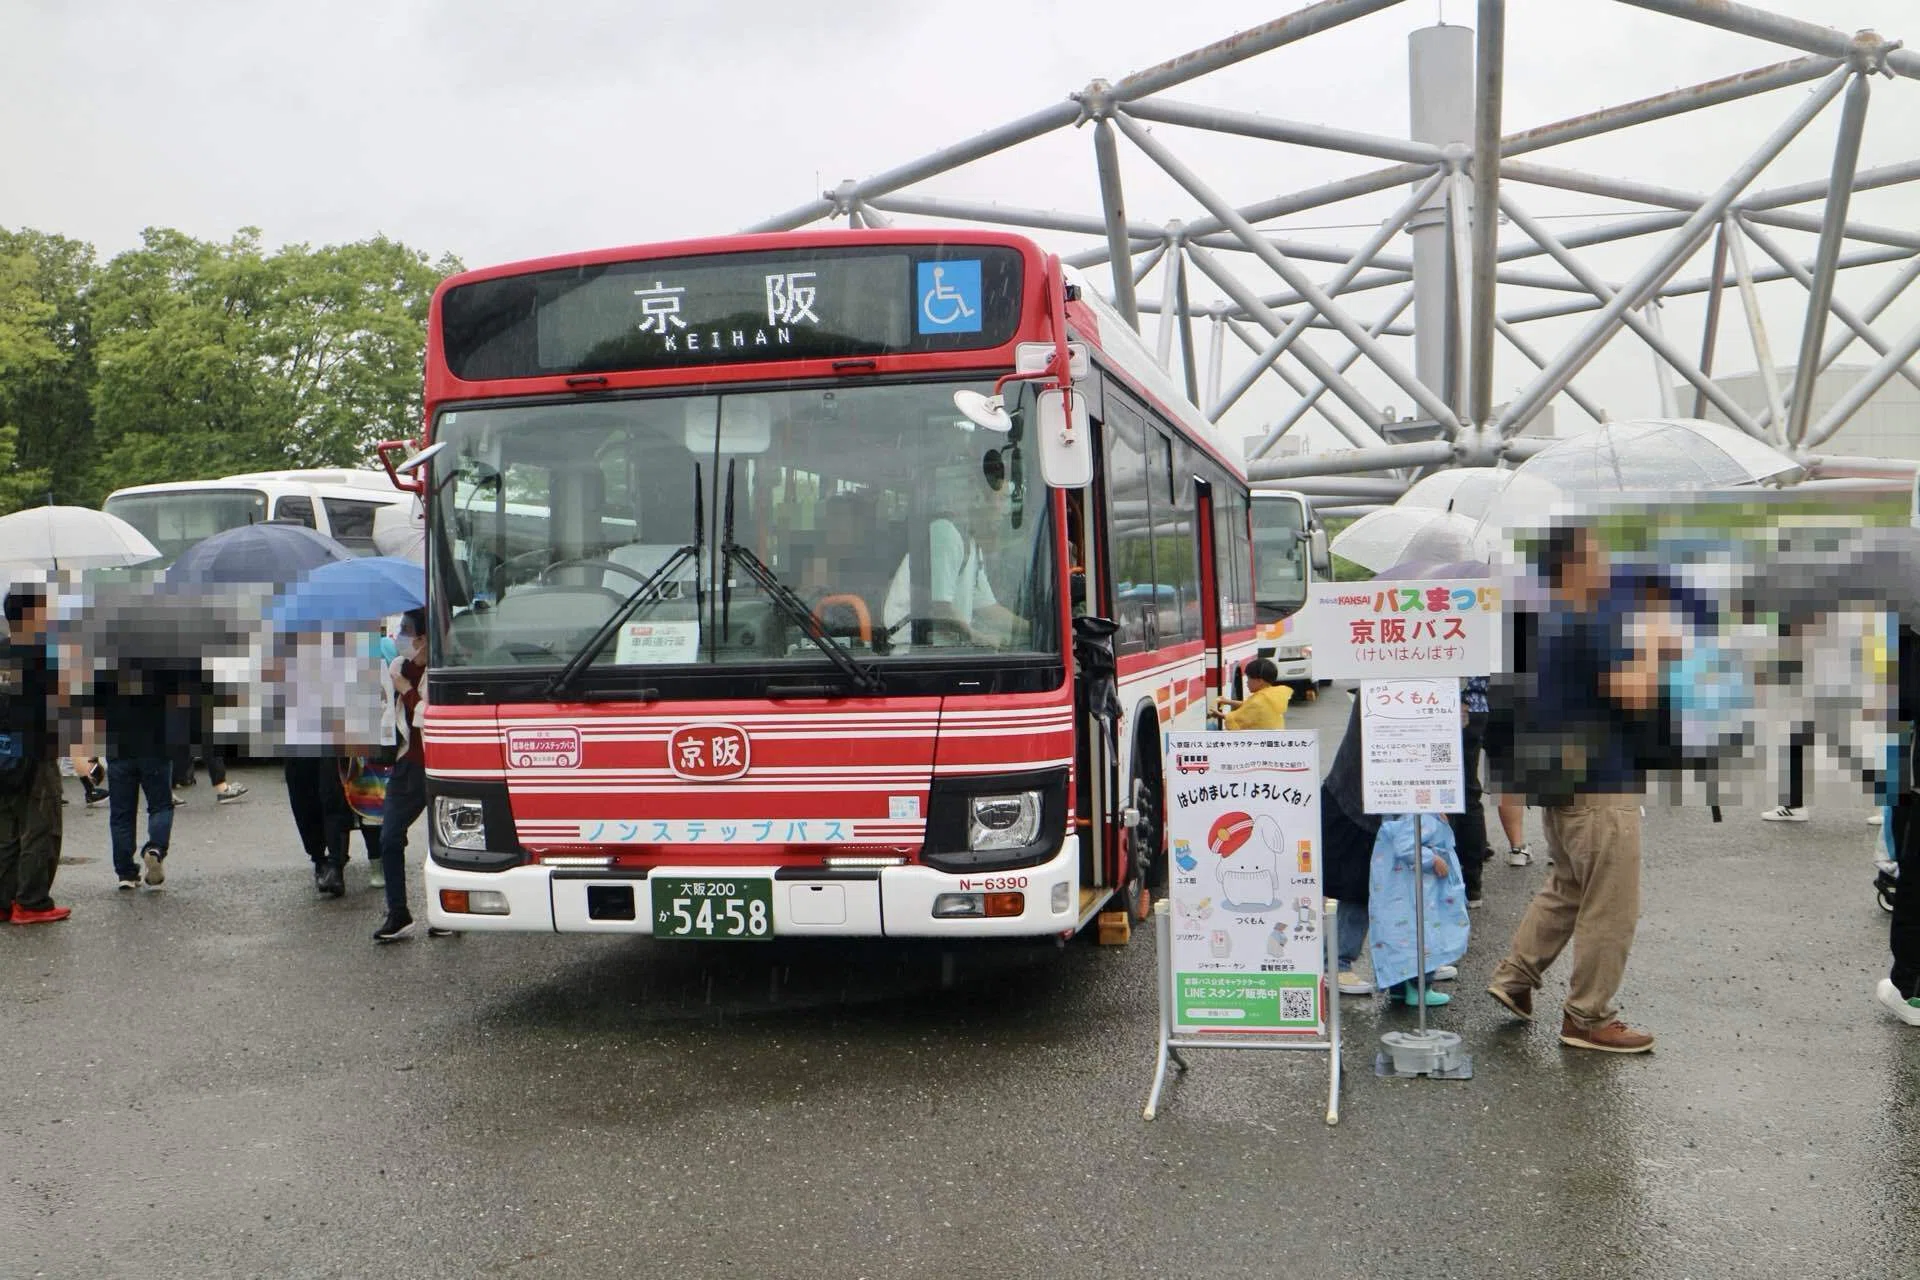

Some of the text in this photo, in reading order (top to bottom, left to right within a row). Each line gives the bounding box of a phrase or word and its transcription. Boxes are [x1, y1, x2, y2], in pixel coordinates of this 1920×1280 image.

[634, 272, 819, 334] 京阪
[665, 328, 790, 351] KEIHAN
[1350, 618, 1466, 644] 京阪バス
[1377, 690, 1440, 706] つくもん
[677, 735, 742, 769] 京阪
[588, 820, 846, 842] ノンステップバス
[680, 882, 736, 896] 大阪200
[960, 876, 1028, 891] N-6390
[658, 898, 768, 935] か 54-58
[1235, 917, 1265, 925] つくもん
